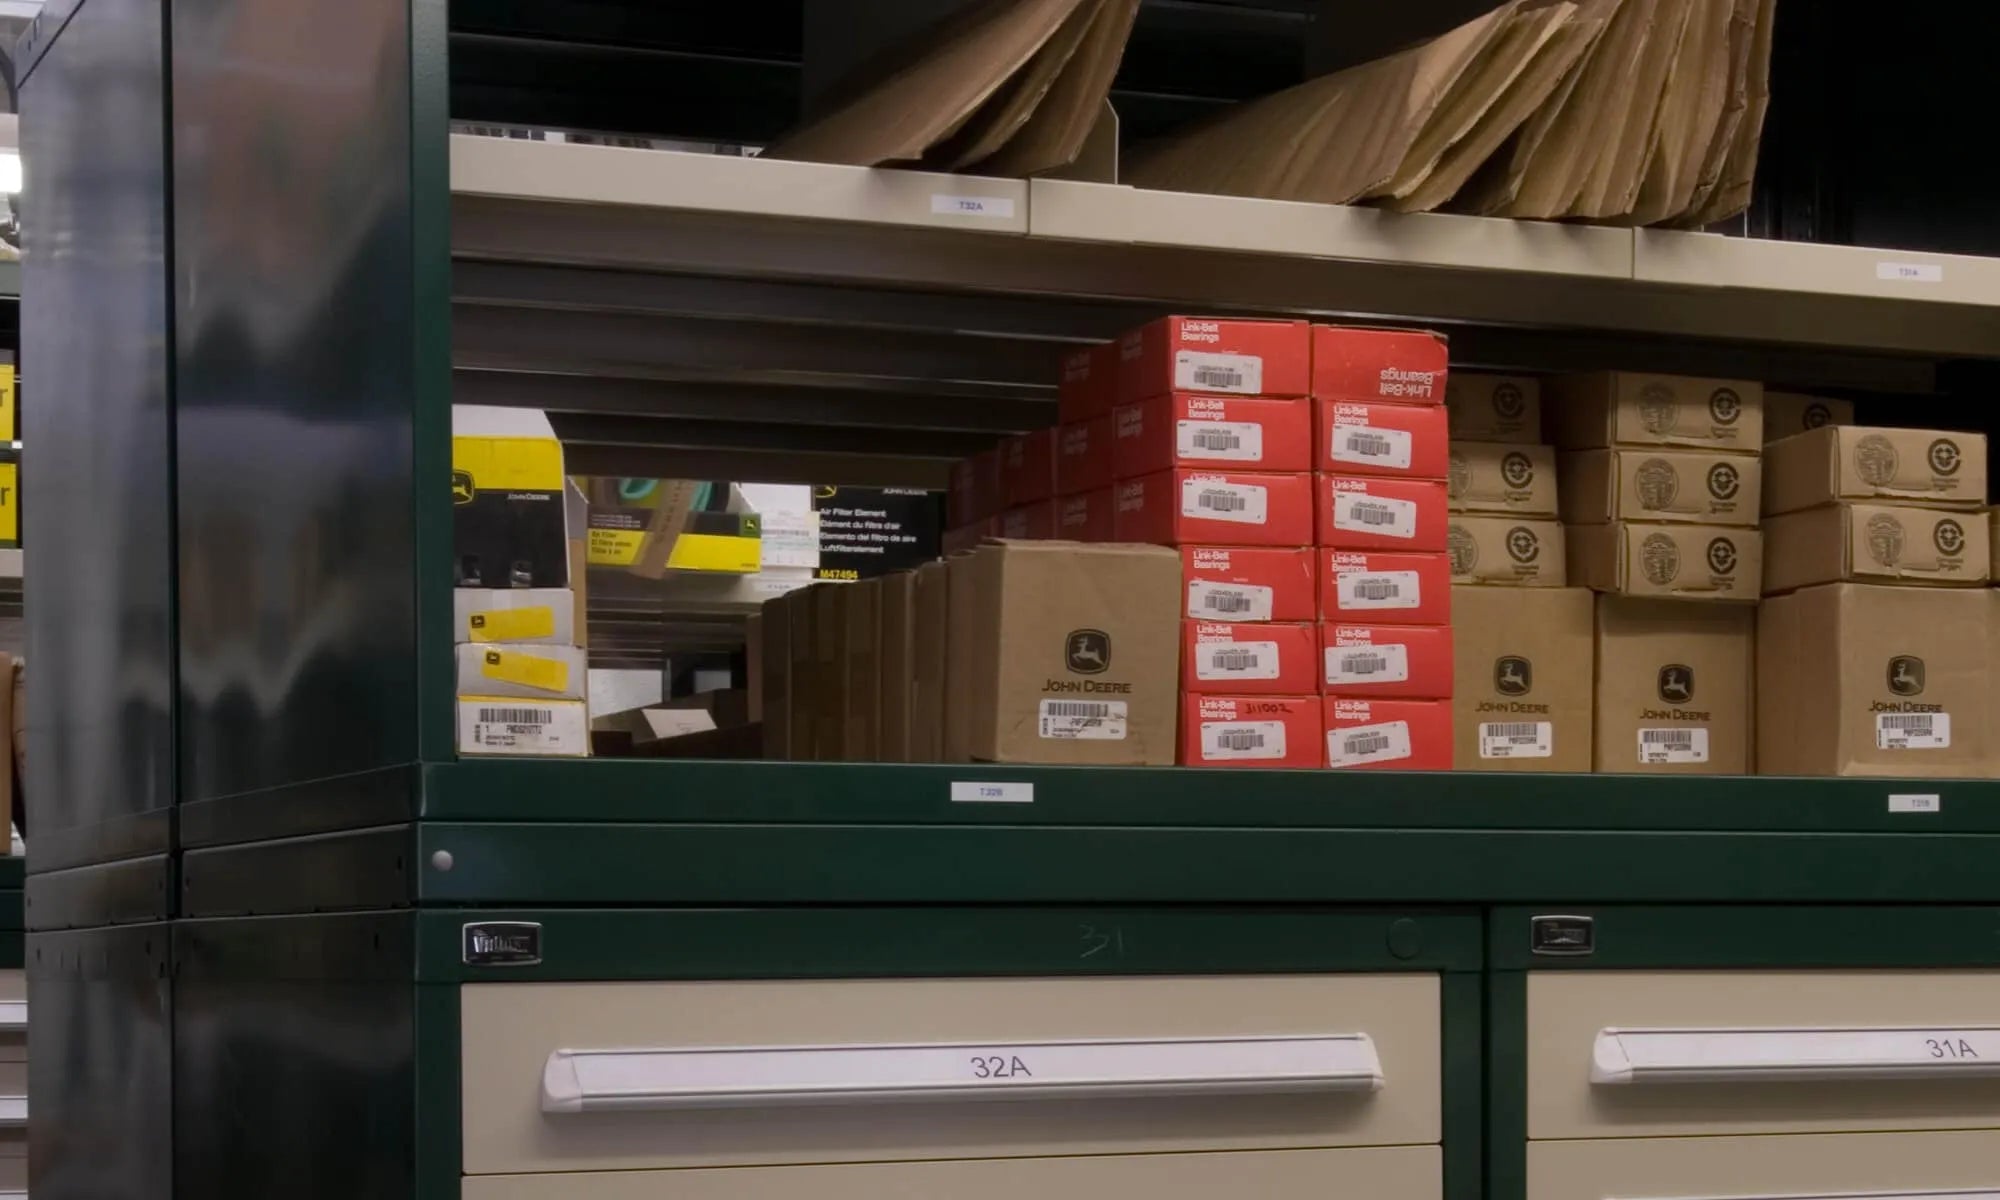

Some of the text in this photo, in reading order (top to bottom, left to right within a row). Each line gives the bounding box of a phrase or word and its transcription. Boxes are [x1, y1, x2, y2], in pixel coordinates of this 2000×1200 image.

[1181, 321, 1218, 332] Link-Belt
[1181, 332, 1219, 343] Bearings
[1380, 367, 1433, 384] Bearings
[1380, 382, 1432, 397] Link-Belt
[1187, 400, 1224, 410] Link-Belt
[1334, 404, 1368, 416] Link-Belt
[1188, 410, 1225, 420] Bearings
[1332, 480, 1367, 490] Link-Belt
[833, 508, 853, 516] Filter
[1193, 551, 1229, 561] Link-Belt
[1331, 554, 1367, 565] Link-Belt
[1193, 560, 1231, 571] Bearings
[820, 569, 858, 578] M47494
[1196, 625, 1232, 635] Link-Belt
[1335, 627, 1370, 639] Link-Belt
[1042, 679, 1132, 693] JOHN DEERE
[1200, 699, 1236, 710] Link-Belt
[1334, 701, 1370, 711] Link-Belt
[1475, 701, 1549, 714] JOHN DEERE
[1869, 700, 1901, 712] JOHN
[1200, 709, 1237, 720] Bearings
[1335, 710, 1371, 721] Bearings
[1640, 708, 1712, 721] JOHN DEERE
[1926, 1039, 1978, 1058] 31A
[971, 1056, 1032, 1078] 32A
